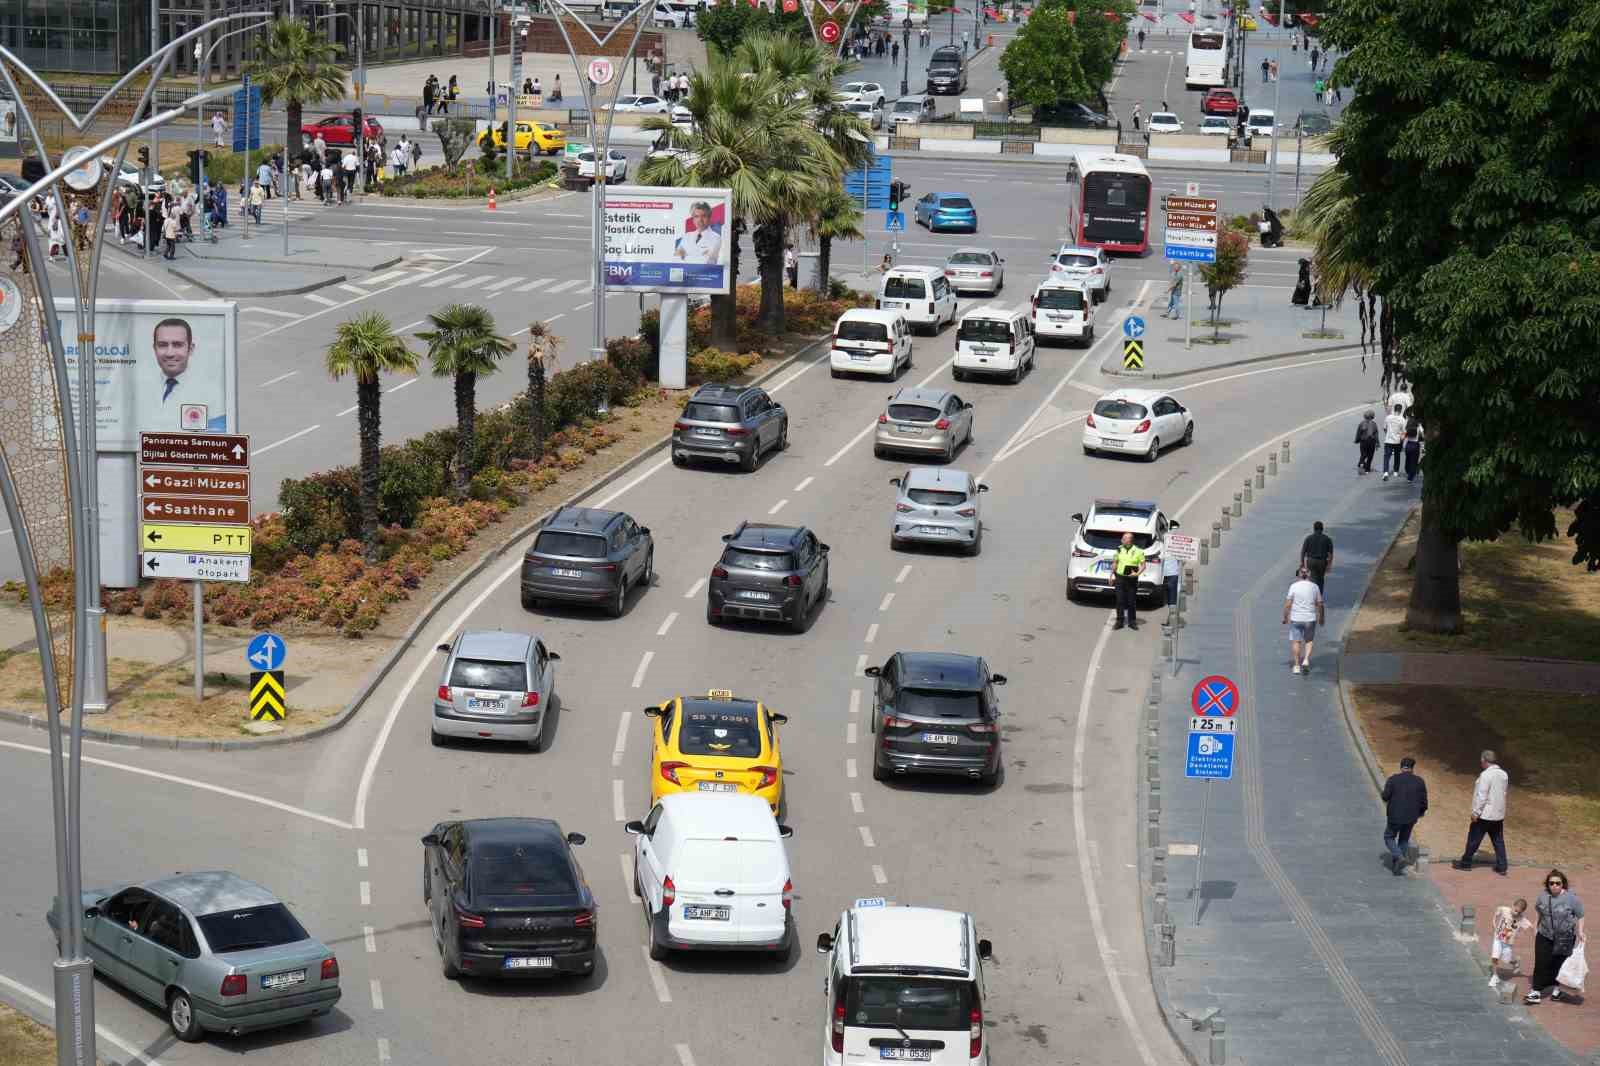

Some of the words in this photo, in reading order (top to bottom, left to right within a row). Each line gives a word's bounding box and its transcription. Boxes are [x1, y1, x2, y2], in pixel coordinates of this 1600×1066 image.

[637, 226, 675, 235] Cerrahi
[142, 436, 189, 446] Panorama
[191, 438, 228, 447] Samsun
[142, 450, 167, 460] Dijital
[170, 450, 208, 460] Gösterim
[164, 476, 193, 488] Gazi
[197, 477, 246, 490] Müzesi
[164, 503, 236, 517] Saathane
[213, 534, 246, 546] PTT
[198, 557, 243, 567] Anakent
[198, 568, 239, 578] Otopark
[1200, 719, 1214, 730] 25
[688, 909, 698, 917] 55
[714, 909, 728, 917] 201
[885, 1048, 895, 1057] 55
